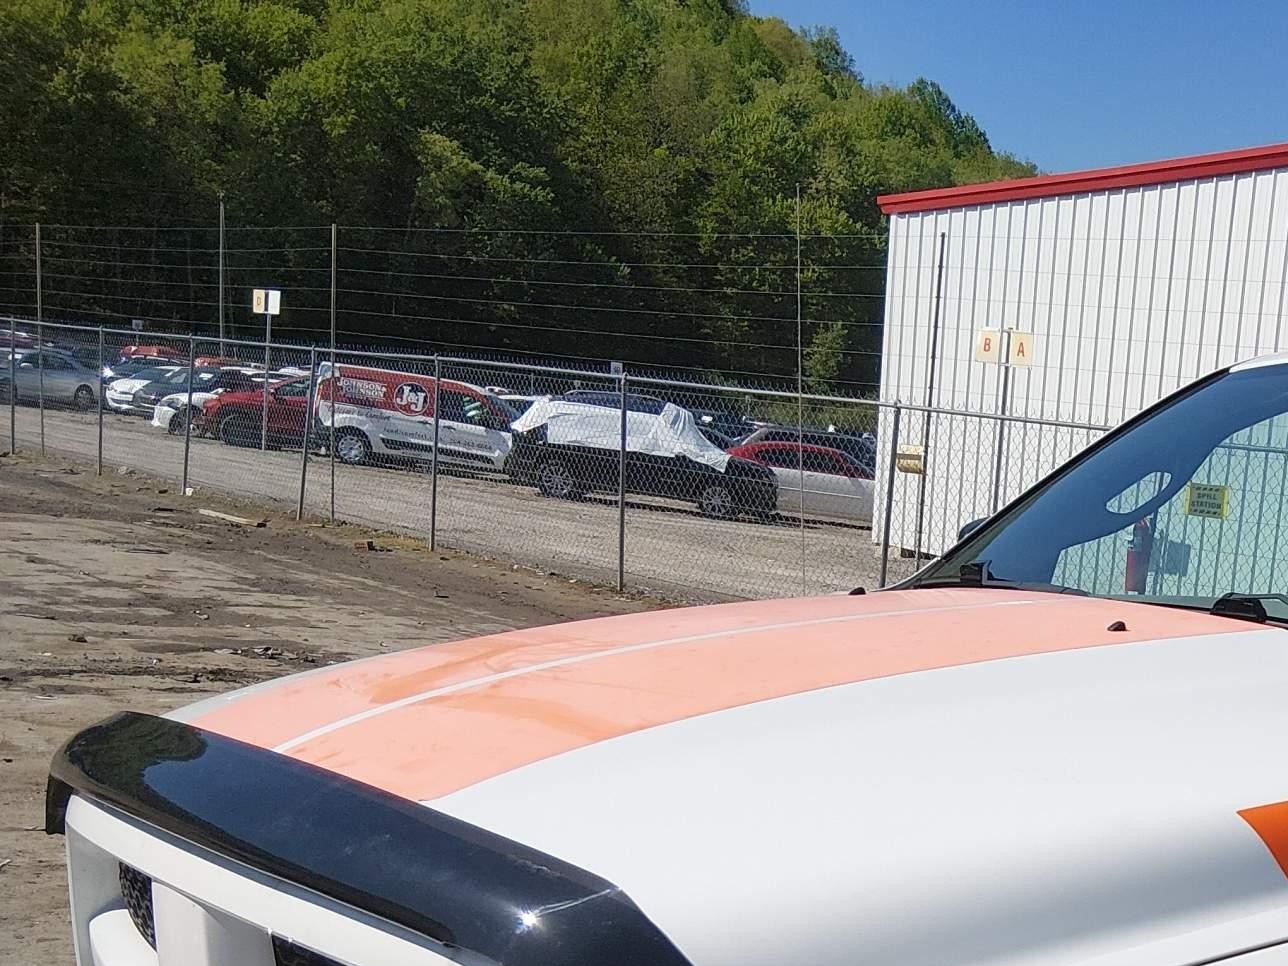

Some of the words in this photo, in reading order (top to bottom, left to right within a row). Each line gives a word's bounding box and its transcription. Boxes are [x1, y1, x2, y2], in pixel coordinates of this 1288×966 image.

[983, 337, 992, 353] B
[1016, 341, 1026, 358] A
[396, 385, 426, 412] J&J
[1197, 492, 1218, 500] SPILL
[1190, 500, 1222, 509] STATION
